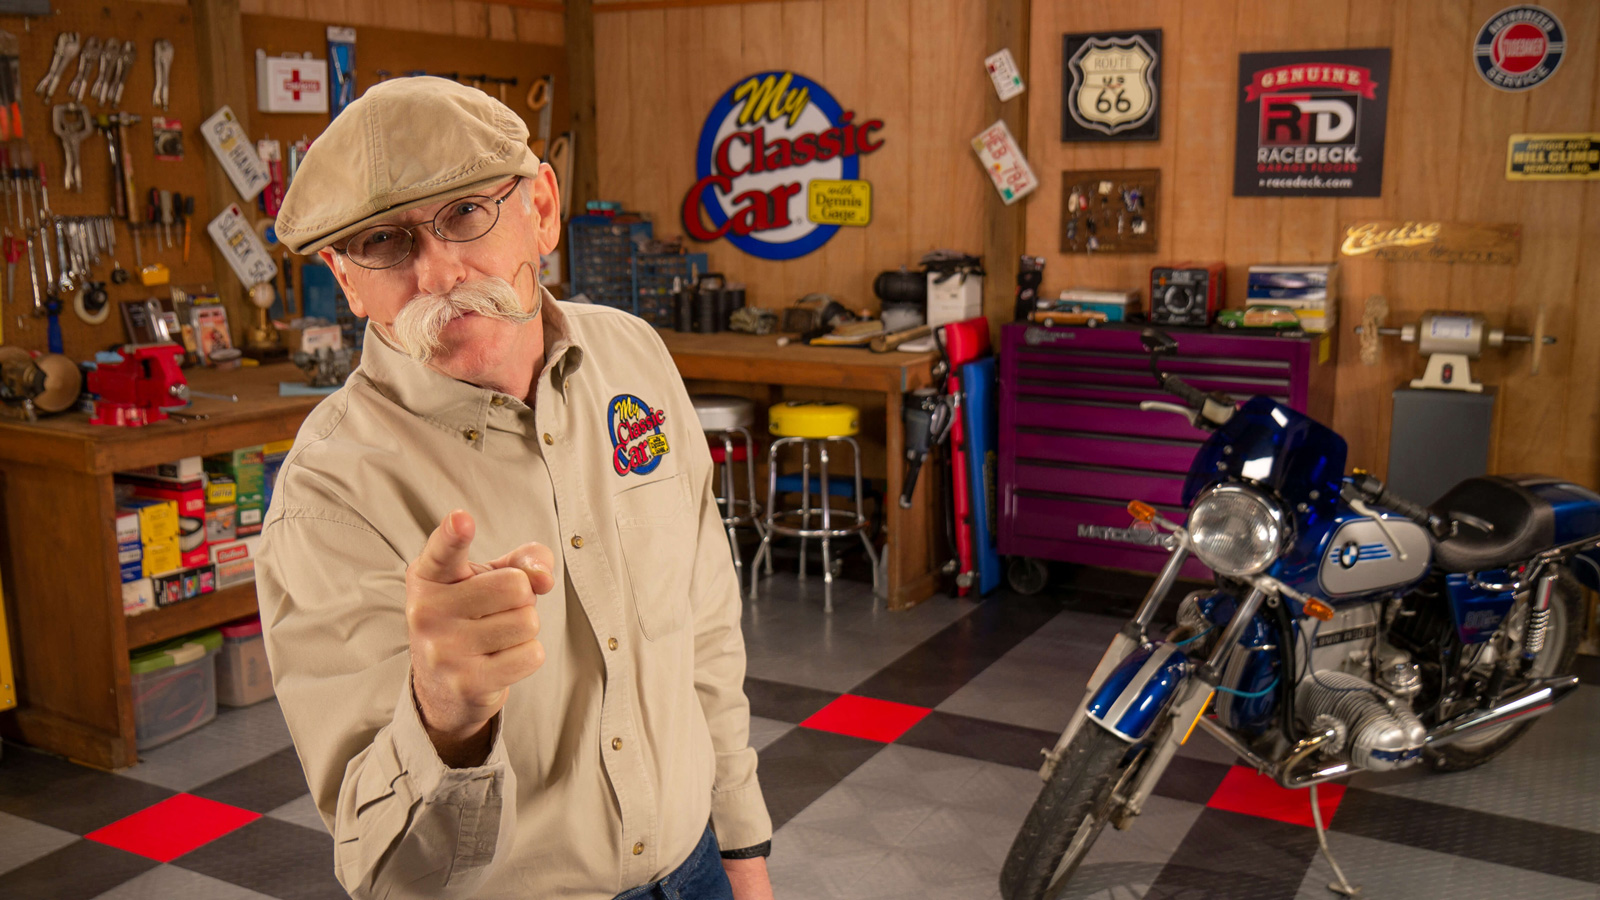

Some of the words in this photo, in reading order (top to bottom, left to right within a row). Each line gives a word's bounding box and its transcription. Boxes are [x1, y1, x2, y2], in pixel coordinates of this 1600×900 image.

[1488, 8, 1555, 36] AUTHORIZED
[1094, 55, 1132, 70] ROUTE
[1261, 66, 1361, 88] GENUINE
[1485, 65, 1549, 88] SERVICE
[733, 71, 811, 127] My
[1096, 89, 1131, 113] 66
[715, 111, 884, 179] Classic
[1257, 147, 1359, 164] RACEDECK
[1514, 151, 1545, 163] HILL
[1548, 150, 1600, 163] CLIMB
[1257, 163, 1306, 173] GARAGE
[1310, 163, 1358, 173] FLOORS
[827, 185, 853, 195] with
[1266, 176, 1352, 188] racedeck.com
[682, 175, 801, 241] Car
[815, 194, 862, 208] Dennis
[821, 207, 856, 221] Gage
[1341, 222, 1441, 256] Cruise
[614, 397, 639, 420] My
[617, 407, 665, 445] Classic
[613, 440, 648, 475] Car
